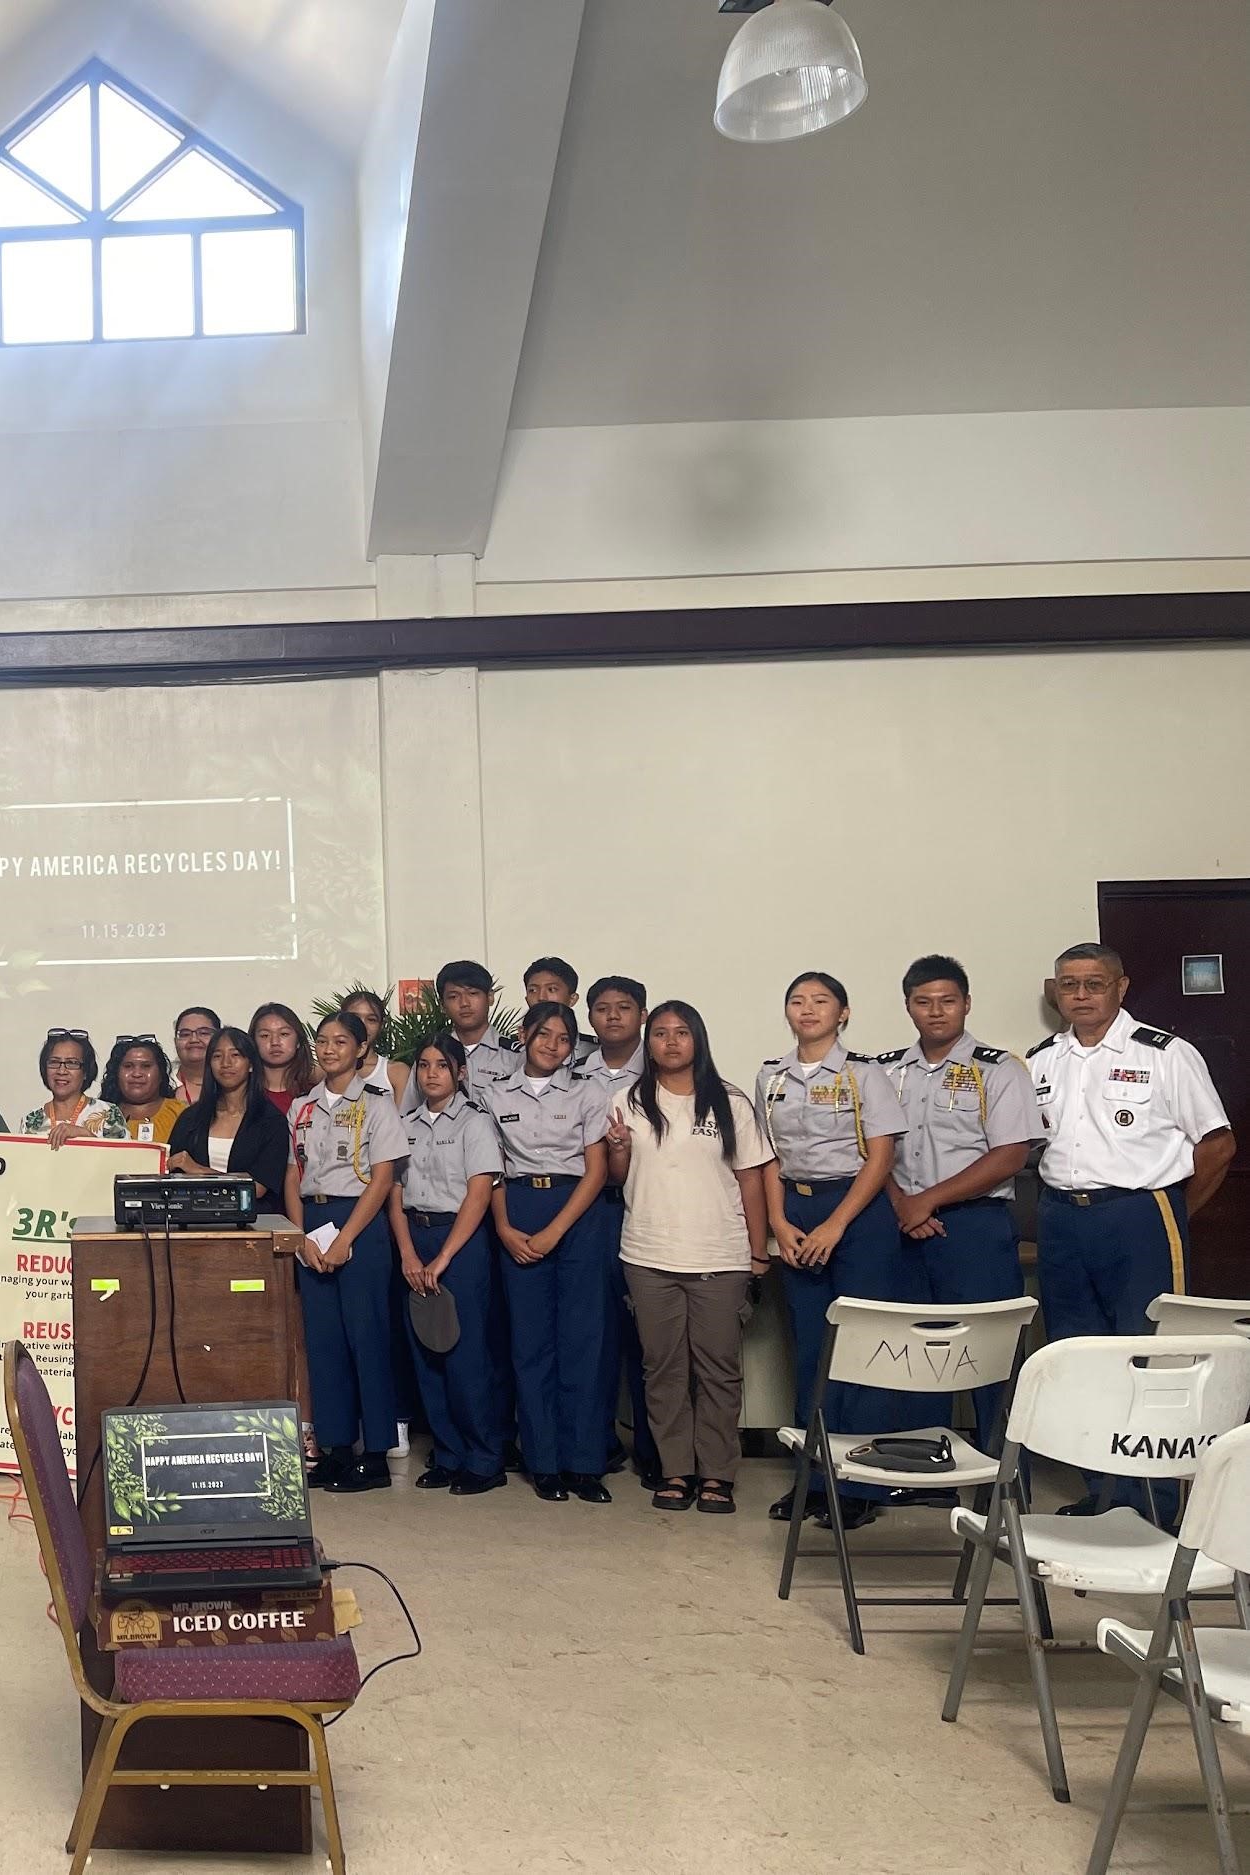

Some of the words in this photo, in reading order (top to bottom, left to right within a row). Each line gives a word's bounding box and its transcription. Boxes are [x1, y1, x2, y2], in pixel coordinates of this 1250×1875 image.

[30, 854, 119, 878] AMERICA
[125, 851, 227, 875] RECYCLES
[233, 850, 281, 872] DAY!
[81, 923, 167, 939] 11.15.2023
[692, 1129, 719, 1138] EASY
[36, 1277, 59, 1286] your
[25, 1290, 48, 1299] your
[865, 1340, 979, 1382] MVA
[145, 1456, 170, 1466] HAPPY
[171, 1454, 205, 1465] AMERICA
[206, 1453, 244, 1464] RECYCLES
[173, 1614, 222, 1633] ICED
[228, 1611, 307, 1631] COFFEE
